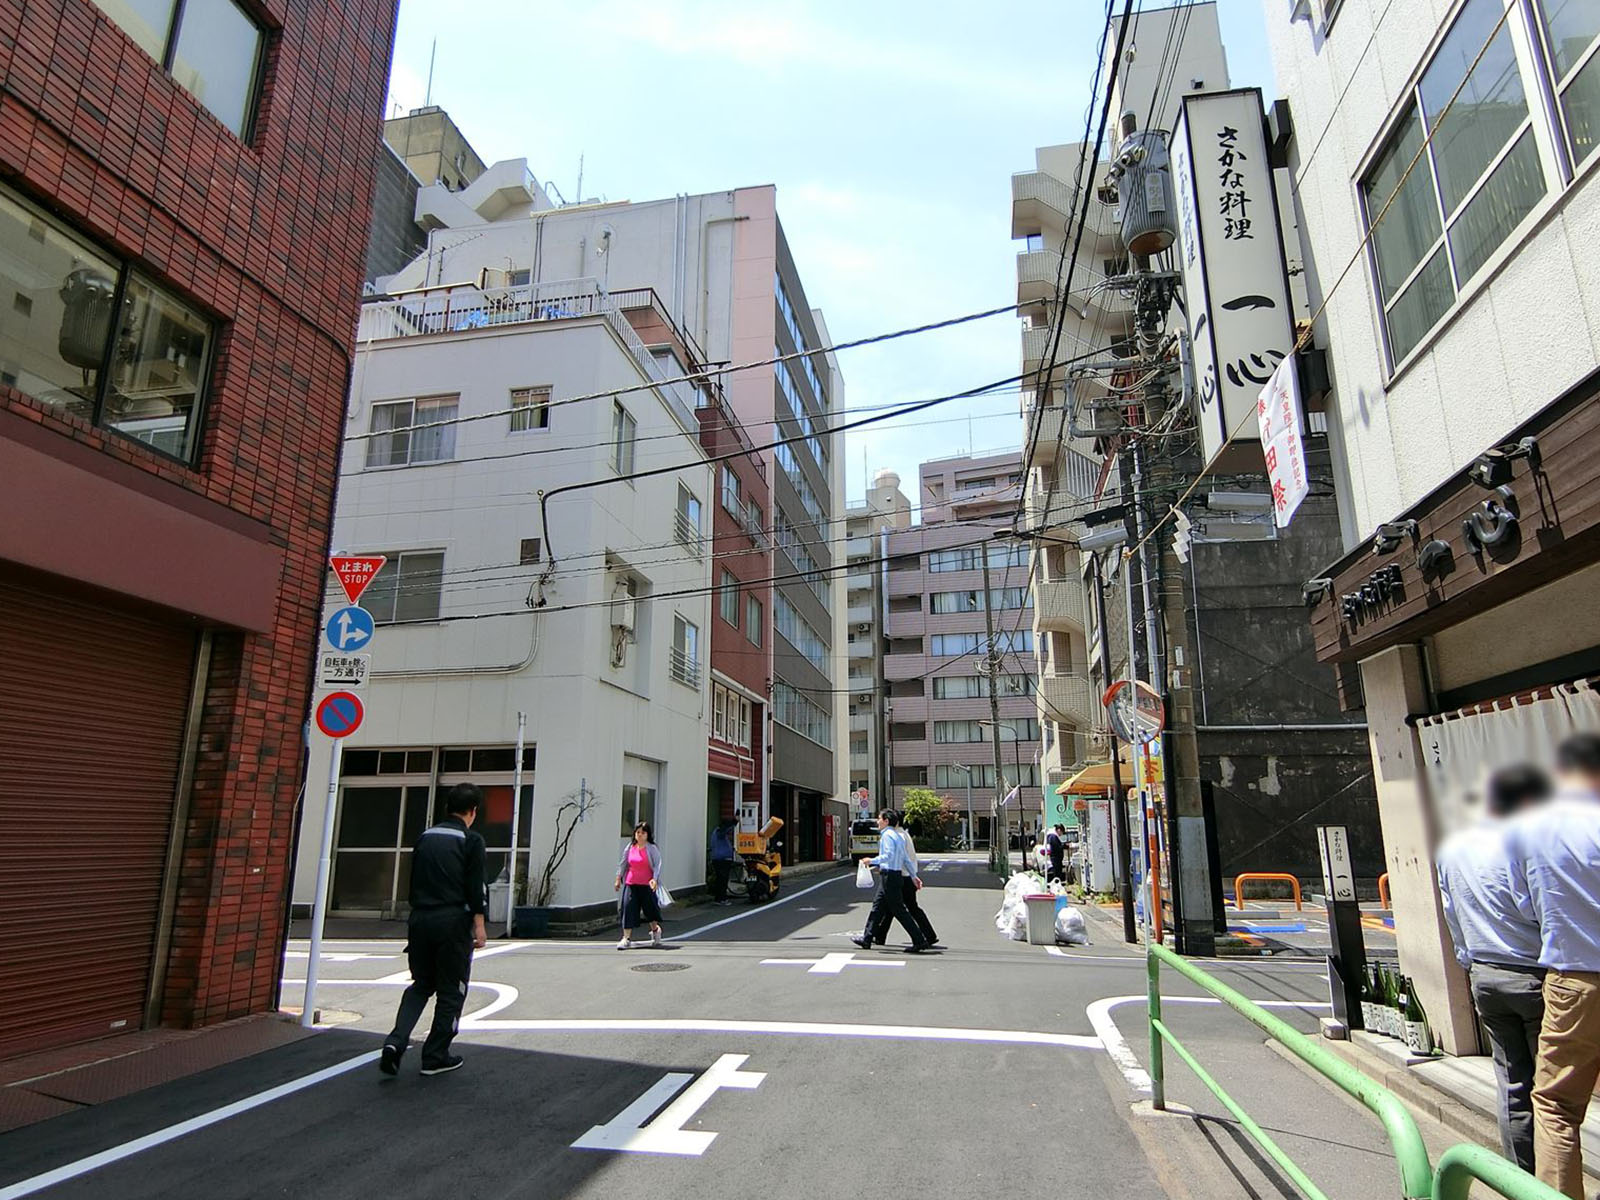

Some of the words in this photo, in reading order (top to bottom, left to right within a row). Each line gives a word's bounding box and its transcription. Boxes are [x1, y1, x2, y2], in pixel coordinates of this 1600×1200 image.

[1217, 126, 1254, 240] さかな料理
[1193, 313, 1216, 413] 一心
[340, 562, 373, 572] 止まれ
[344, 574, 368, 584] STOP
[324, 657, 366, 668] 自転車を除く
[323, 668, 365, 678] 一方通行
[1336, 874, 1352, 898] 一心
